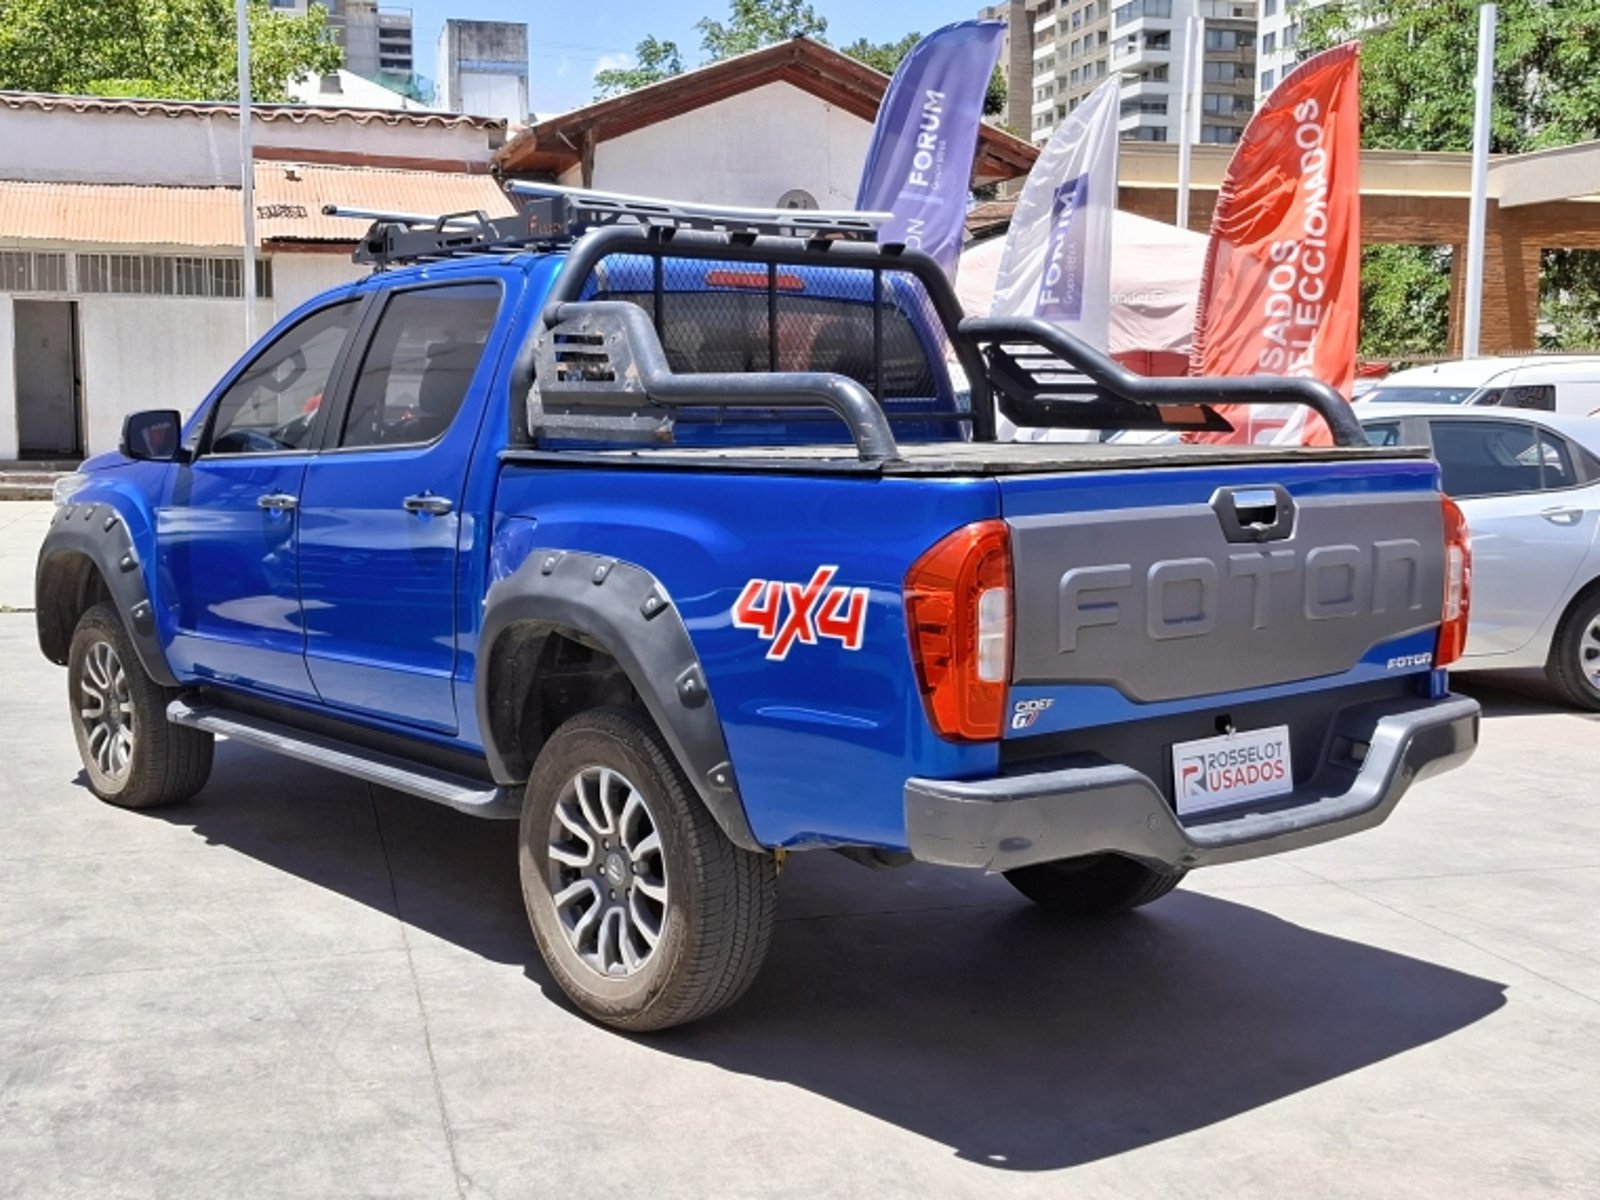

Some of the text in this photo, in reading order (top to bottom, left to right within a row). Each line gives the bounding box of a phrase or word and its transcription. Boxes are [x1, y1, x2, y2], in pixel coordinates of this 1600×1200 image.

[908, 89, 946, 187] FORUM
[1256, 239, 1300, 377] SADOS
[1058, 538, 1422, 654] FOTON
[1386, 652, 1432, 669] FOTON
[1208, 741, 1283, 769] ROSSELOT
[1209, 760, 1285, 791] USADOS
